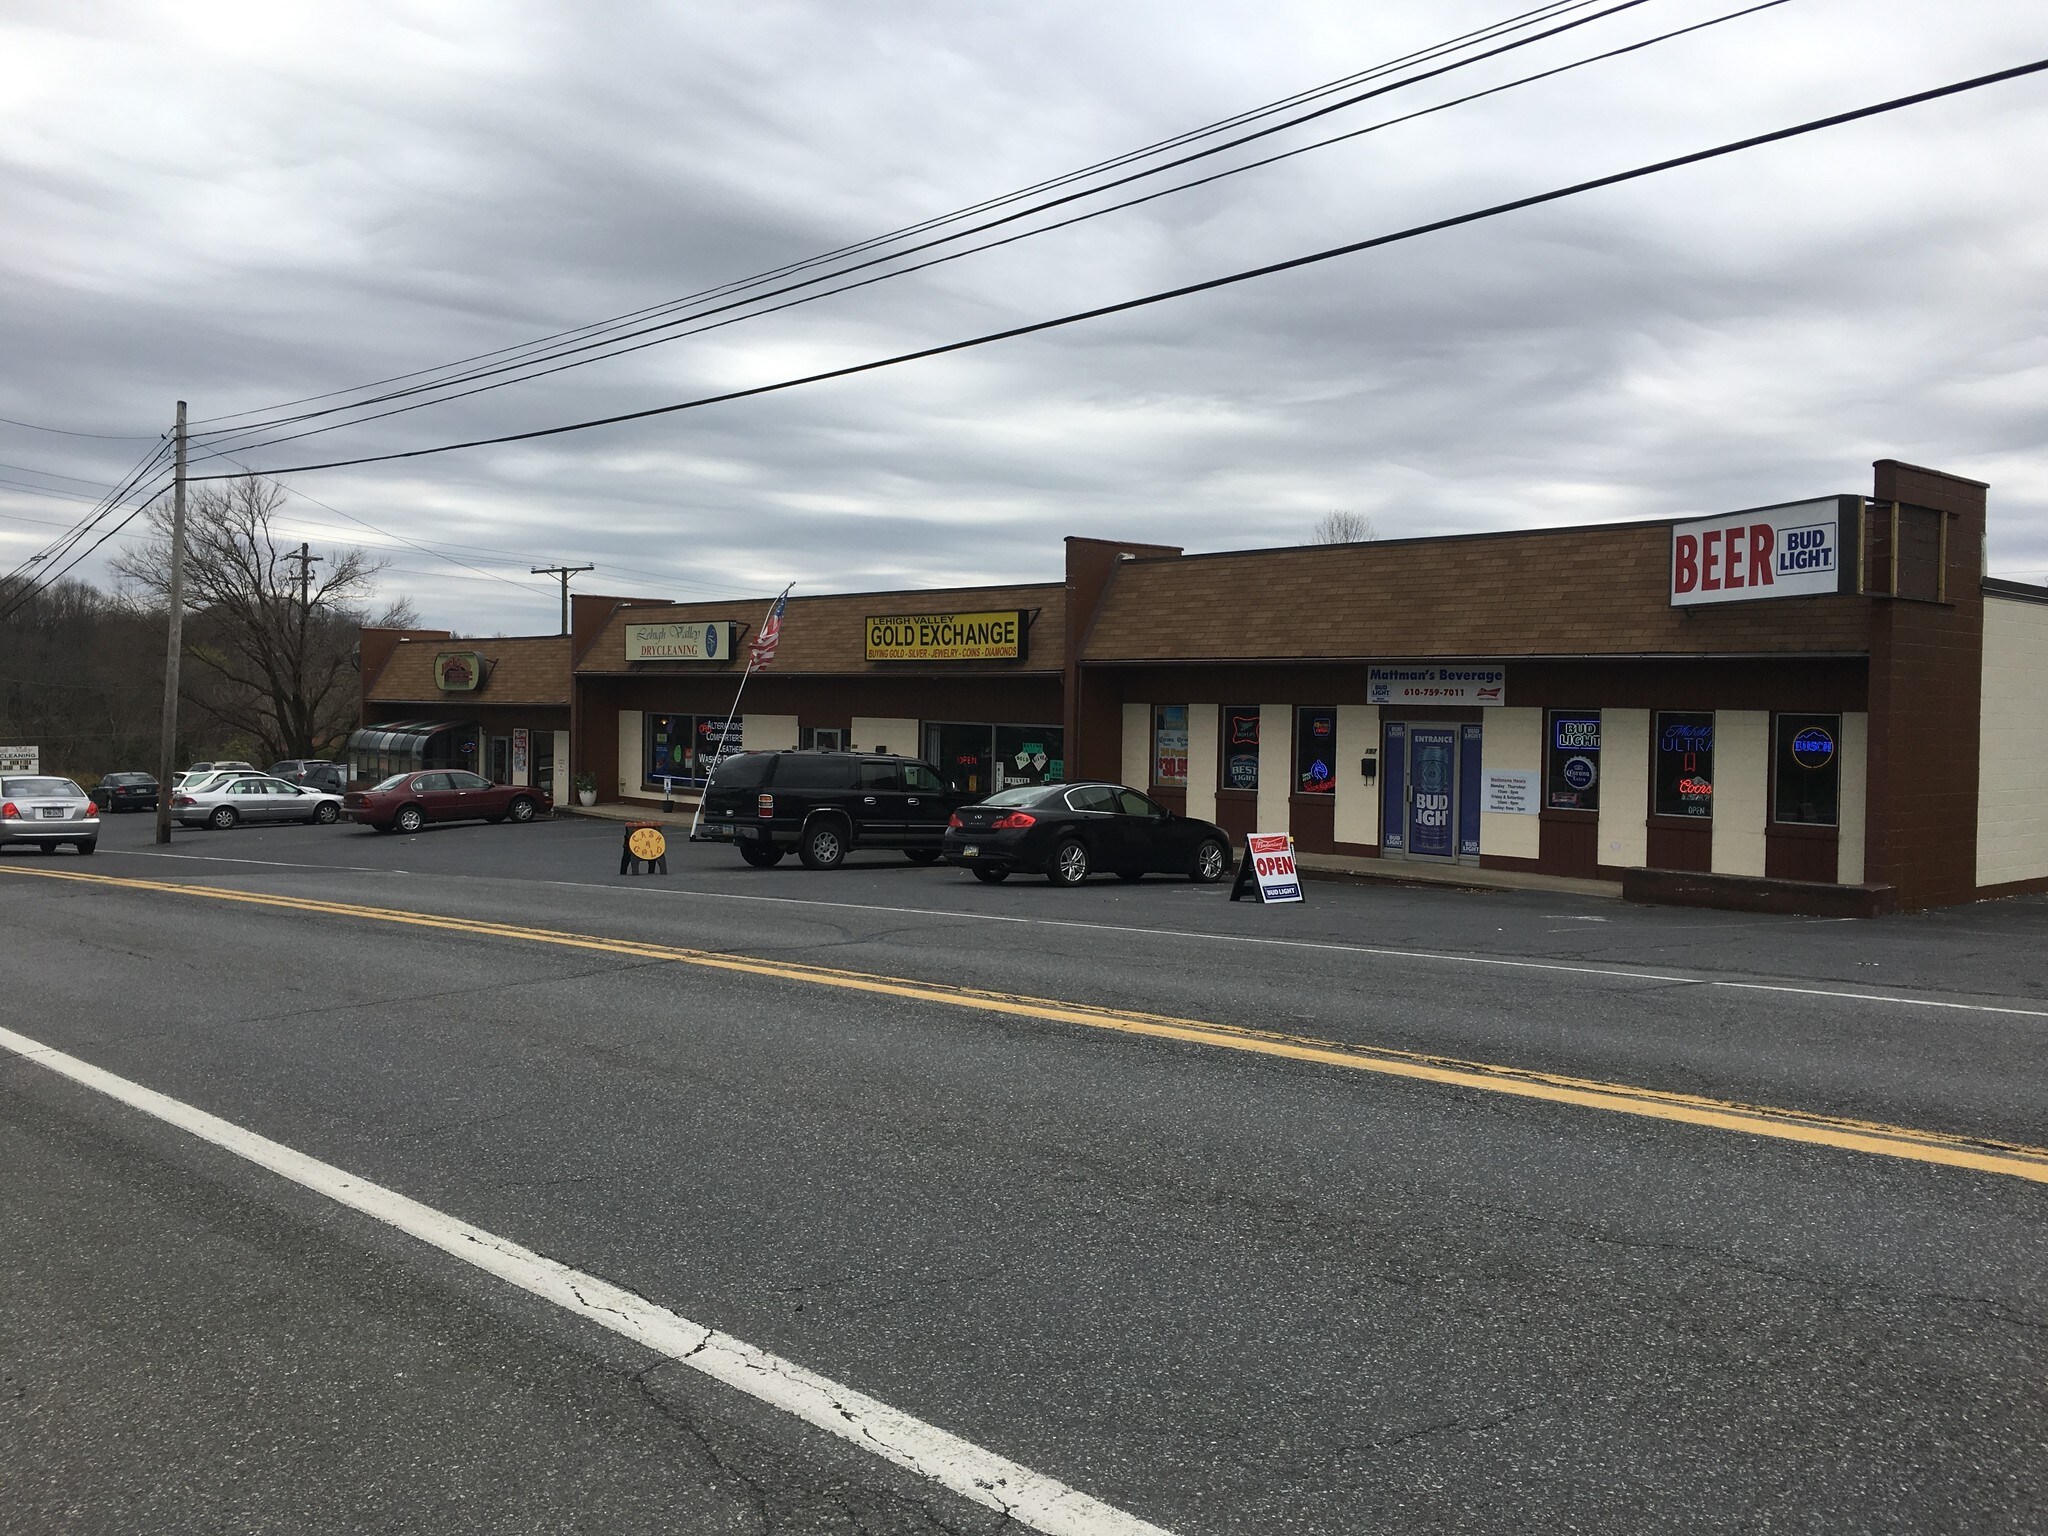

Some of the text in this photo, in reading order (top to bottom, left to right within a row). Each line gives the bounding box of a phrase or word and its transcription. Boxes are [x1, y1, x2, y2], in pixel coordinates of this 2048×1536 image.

[1787, 529, 1825, 550] BUD
[1675, 524, 1774, 594] BEER
[873, 616, 955, 625] LEHIGH VALLEY
[636, 627, 666, 644] Lehigh
[669, 625, 700, 642] Valley
[871, 621, 1015, 647] GOLD EXCHANGE
[641, 644, 698, 656] DRYCLEANING
[868, 650, 888, 658] BUYING
[889, 650, 904, 659] GOLD
[908, 649, 927, 658] SILVER
[931, 648, 959, 658] JEWELRY
[962, 647, 981, 657] COINS
[985, 646, 1017, 656] DIAMONDS
[1370, 669, 1502, 683] Mattman's Beverage
[1403, 688, 1464, 696] 610-759-7011
[1566, 723, 1597, 734] BUD
[1415, 735, 1453, 743] ENTRANCE
[1794, 741, 1832, 752] BUSCH
[958, 756, 977, 764] OPEN
[1232, 766, 1257, 775] BEST
[1566, 769, 1590, 777] Corona
[1680, 779, 1713, 794] Coors
[1416, 793, 1448, 810] BUD
[1688, 806, 1705, 815] OPEN
[632, 830, 662, 843] CASH
[1256, 856, 1294, 876] OPEN
[1266, 887, 1295, 896] BUD LIGHT
